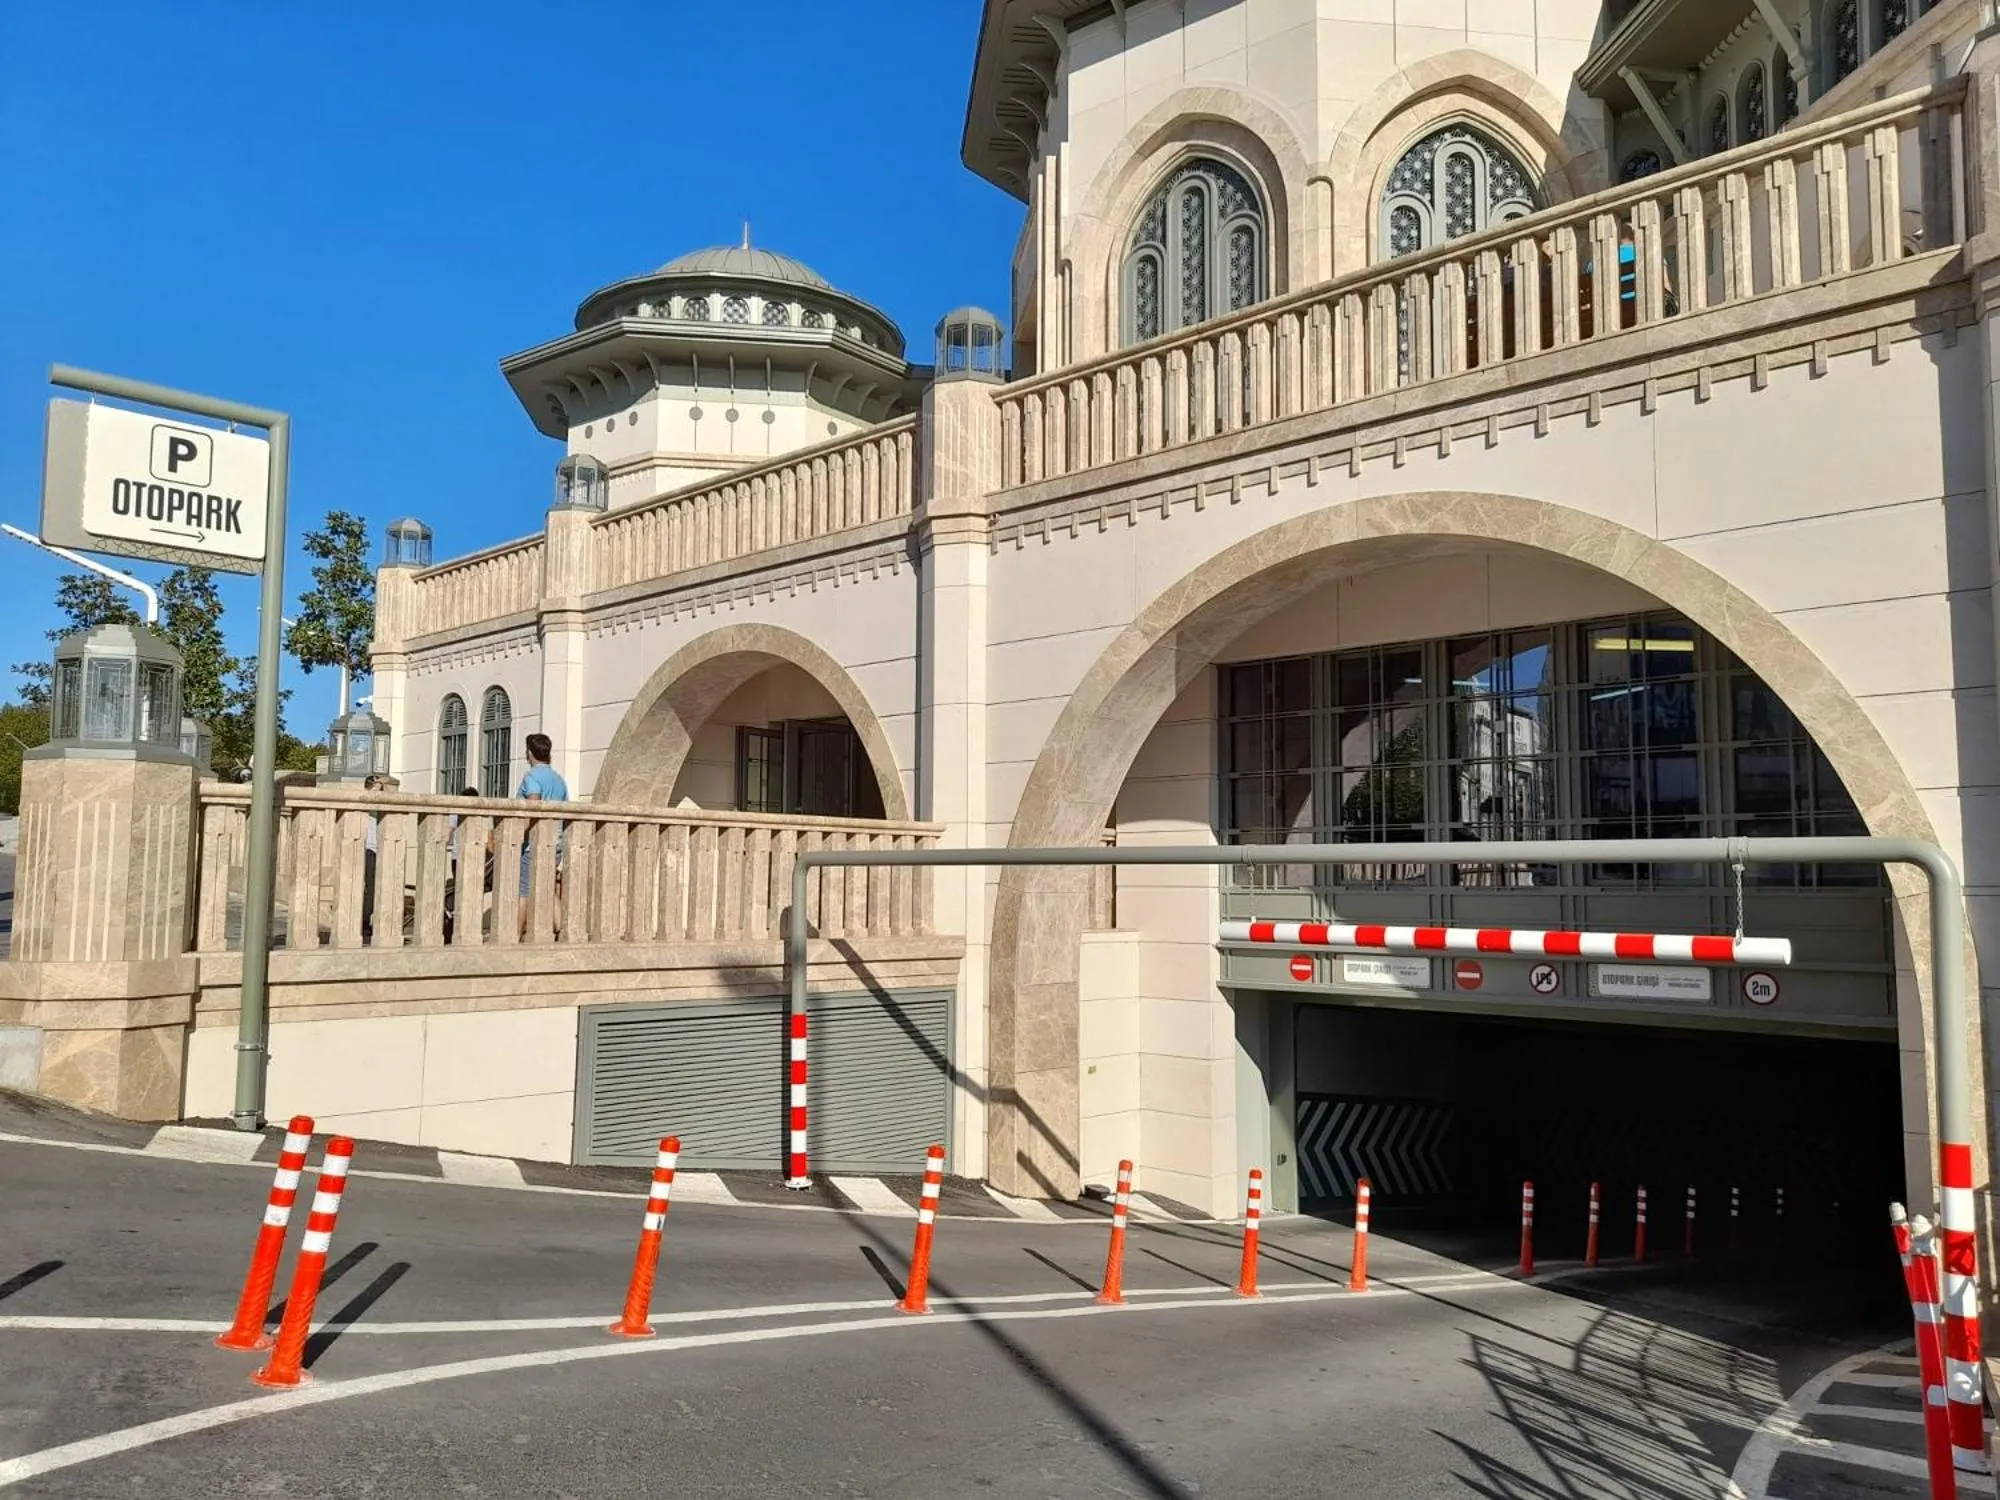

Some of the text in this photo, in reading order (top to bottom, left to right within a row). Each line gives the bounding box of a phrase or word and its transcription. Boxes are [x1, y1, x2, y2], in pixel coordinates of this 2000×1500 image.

[167, 436, 198, 473] P
[112, 477, 243, 534] OTOPARK
[1752, 980, 1770, 997] 2m
